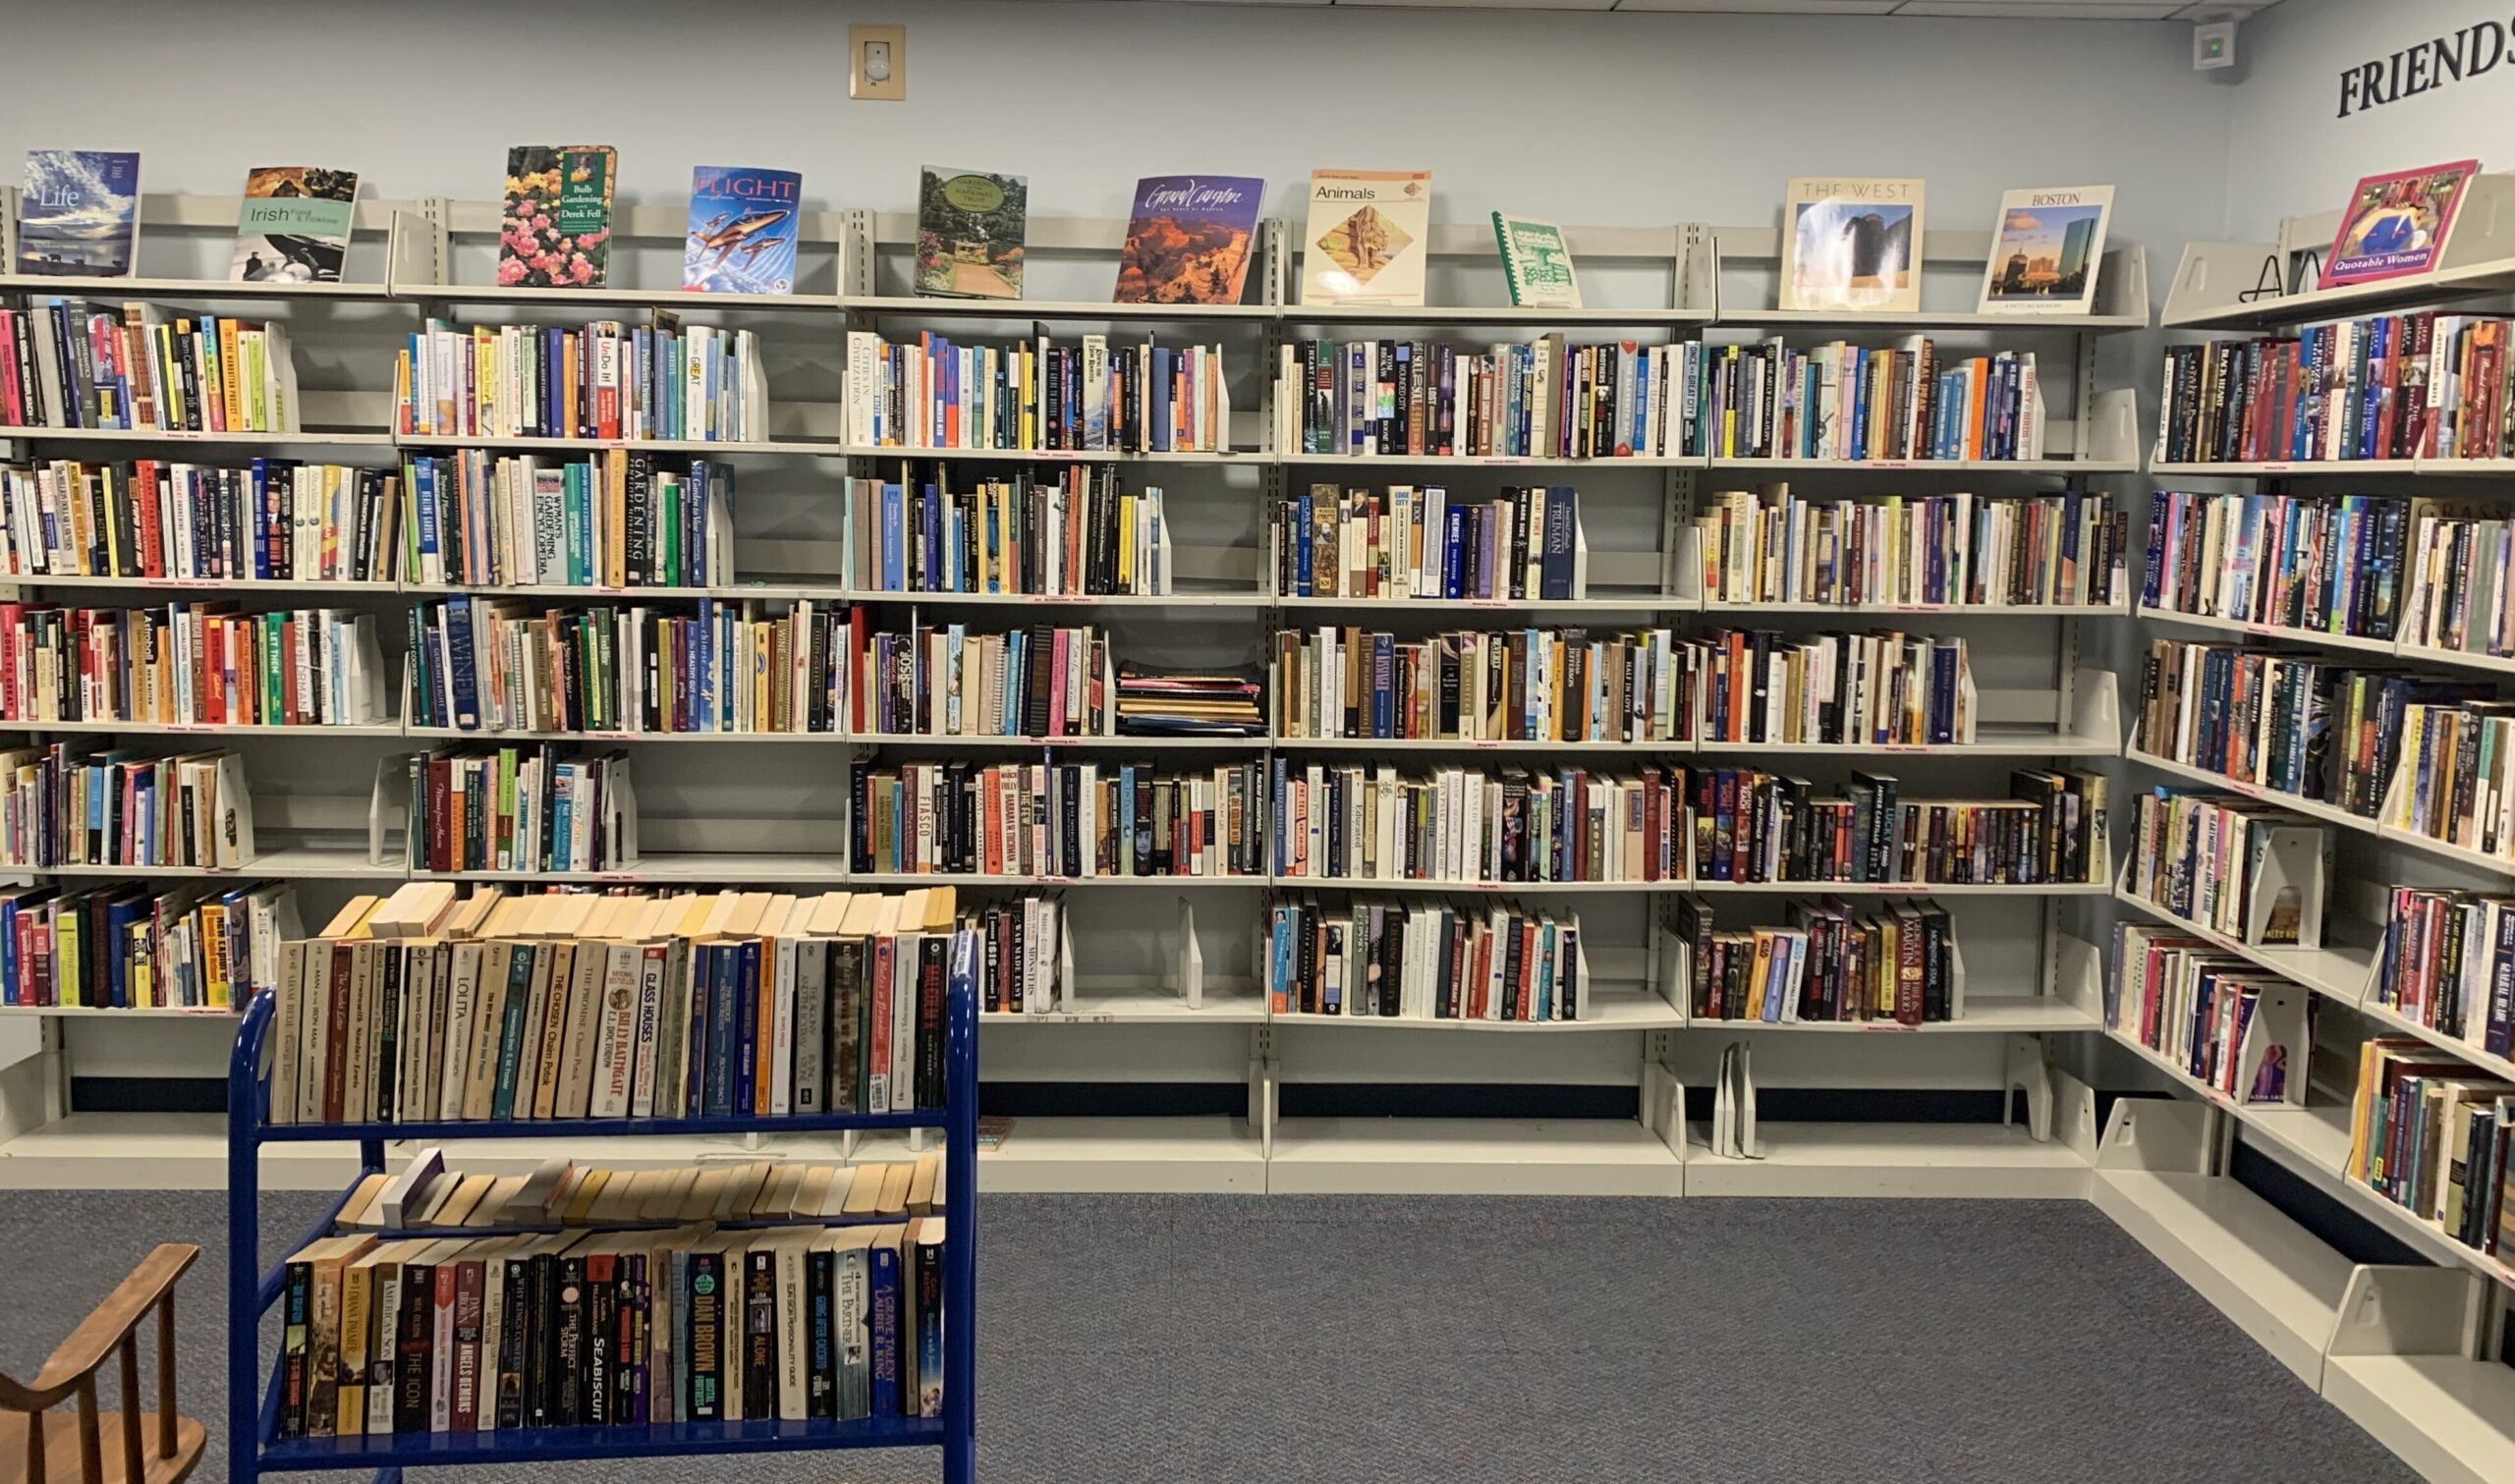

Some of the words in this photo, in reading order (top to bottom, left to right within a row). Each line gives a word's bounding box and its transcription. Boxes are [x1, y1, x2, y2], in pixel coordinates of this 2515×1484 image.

[39, 185, 79, 206] Life
[694, 177, 795, 197] FLIGHT
[955, 189, 992, 197] NATIONAL
[957, 179, 992, 188] GARDENS
[1316, 187, 1375, 199] Animals
[1803, 183, 1841, 197] THE
[1852, 184, 1910, 198] WEST
[251, 207, 289, 221] Irish
[562, 195, 603, 205] Gardening
[587, 209, 601, 218] Fell
[2032, 192, 2082, 206] BOSTON
[2335, 256, 2384, 270] Quotable
[2387, 252, 2427, 265] Women
[181, 336, 191, 355] Stem
[601, 341, 614, 369] UnDo
[183, 356, 193, 372] Cells
[642, 349, 650, 379] Problem
[690, 357, 700, 386] GREAT
[862, 347, 871, 381] CITIES
[1598, 348, 1607, 383] BROTHERS
[1920, 342, 1932, 380] ANIMAL
[601, 372, 615, 382] It!
[1687, 375, 1696, 397] GREAT
[642, 380, 650, 416] Drinkers
[1918, 384, 1928, 412] SPEAK
[2217, 379, 2226, 408] HEART
[296, 471, 305, 511] Abundance
[309, 471, 318, 511] Abundance
[421, 490, 432, 515] HEALING
[633, 459, 645, 561] GARDENING
[693, 516, 701, 533] Vase
[1413, 506, 1422, 523] DOC
[2397, 502, 2407, 546] BARBARA
[423, 517, 434, 541] GARDENS
[536, 496, 547, 575] ENCYCLOPEDIA
[546, 496, 555, 560] GARDENING
[1451, 513, 1460, 543] ENEMIES
[1550, 502, 1562, 554] TRUMAN
[143, 616, 153, 661] Astroball
[295, 615, 304, 647] SUZE
[270, 649, 279, 674] THEM
[452, 635, 474, 687] WINE
[1375, 655, 1391, 690] KISSINGER
[1567, 645, 1576, 687] JEFFERSON
[297, 666, 307, 709] ORMAN
[1005, 794, 1016, 824] BARBARA
[1020, 790, 1030, 803] THE
[920, 797, 930, 837] FIASCO
[1021, 805, 1031, 825] FEW
[1354, 804, 1363, 849] Educated
[1883, 807, 1894, 842] LUCKY
[1007, 832, 1017, 862] TUCHMAN
[2207, 814, 2216, 853] HEARTWOOD
[988, 941, 997, 966] ISIS
[1903, 919, 1914, 965] MARTIN
[1929, 930, 1938, 963] MORNING
[554, 974, 564, 991] THE
[584, 966, 593, 986] THE
[643, 973, 656, 1004] GLASS
[923, 964, 941, 1018] MALCOLM
[550, 992, 562, 1028] CHOSEN
[579, 988, 591, 1028] PROMISE
[617, 1012, 631, 1040] BILLY
[641, 1006, 654, 1042] HOUSES
[546, 1031, 557, 1059] Chaim
[574, 1031, 585, 1057] Chaim
[542, 1062, 553, 1086] Potok
[572, 1059, 583, 1081] Potok
[610, 1041, 627, 1097] BATHGATE
[516, 1278, 525, 1301] WHY
[842, 1271, 854, 1296] THE
[348, 1292, 359, 1318] DIANA
[383, 1283, 395, 1334] AMERICAN
[458, 1292, 470, 1325] BROWN
[469, 1297, 479, 1318] DAN
[515, 1303, 525, 1330] KINGS
[695, 1295, 715, 1322] DAN
[875, 1290, 884, 1334] LAURIE
[885, 1296, 895, 1335] GRAVE
[345, 1320, 358, 1353] PALMER
[842, 1299, 855, 1344] PARTNER
[382, 1338, 394, 1358] SON
[513, 1331, 524, 1371] CONFESS
[567, 1334, 579, 1369] PERFECT
[695, 1325, 715, 1372] BROWN
[754, 1336, 766, 1367] ALONE
[874, 1337, 884, 1347] R.
[409, 1352, 422, 1374] THE
[460, 1344, 474, 1375] ANGELS
[874, 1350, 884, 1380] KING
[885, 1338, 895, 1383] TALENT
[406, 1378, 420, 1408] ICON
[592, 1338, 605, 1421] SEABISCUIT
[695, 1375, 705, 1406] FORTRESS
[705, 1378, 714, 1403] DIGITAL
[458, 1377, 473, 1413] DEMONS
